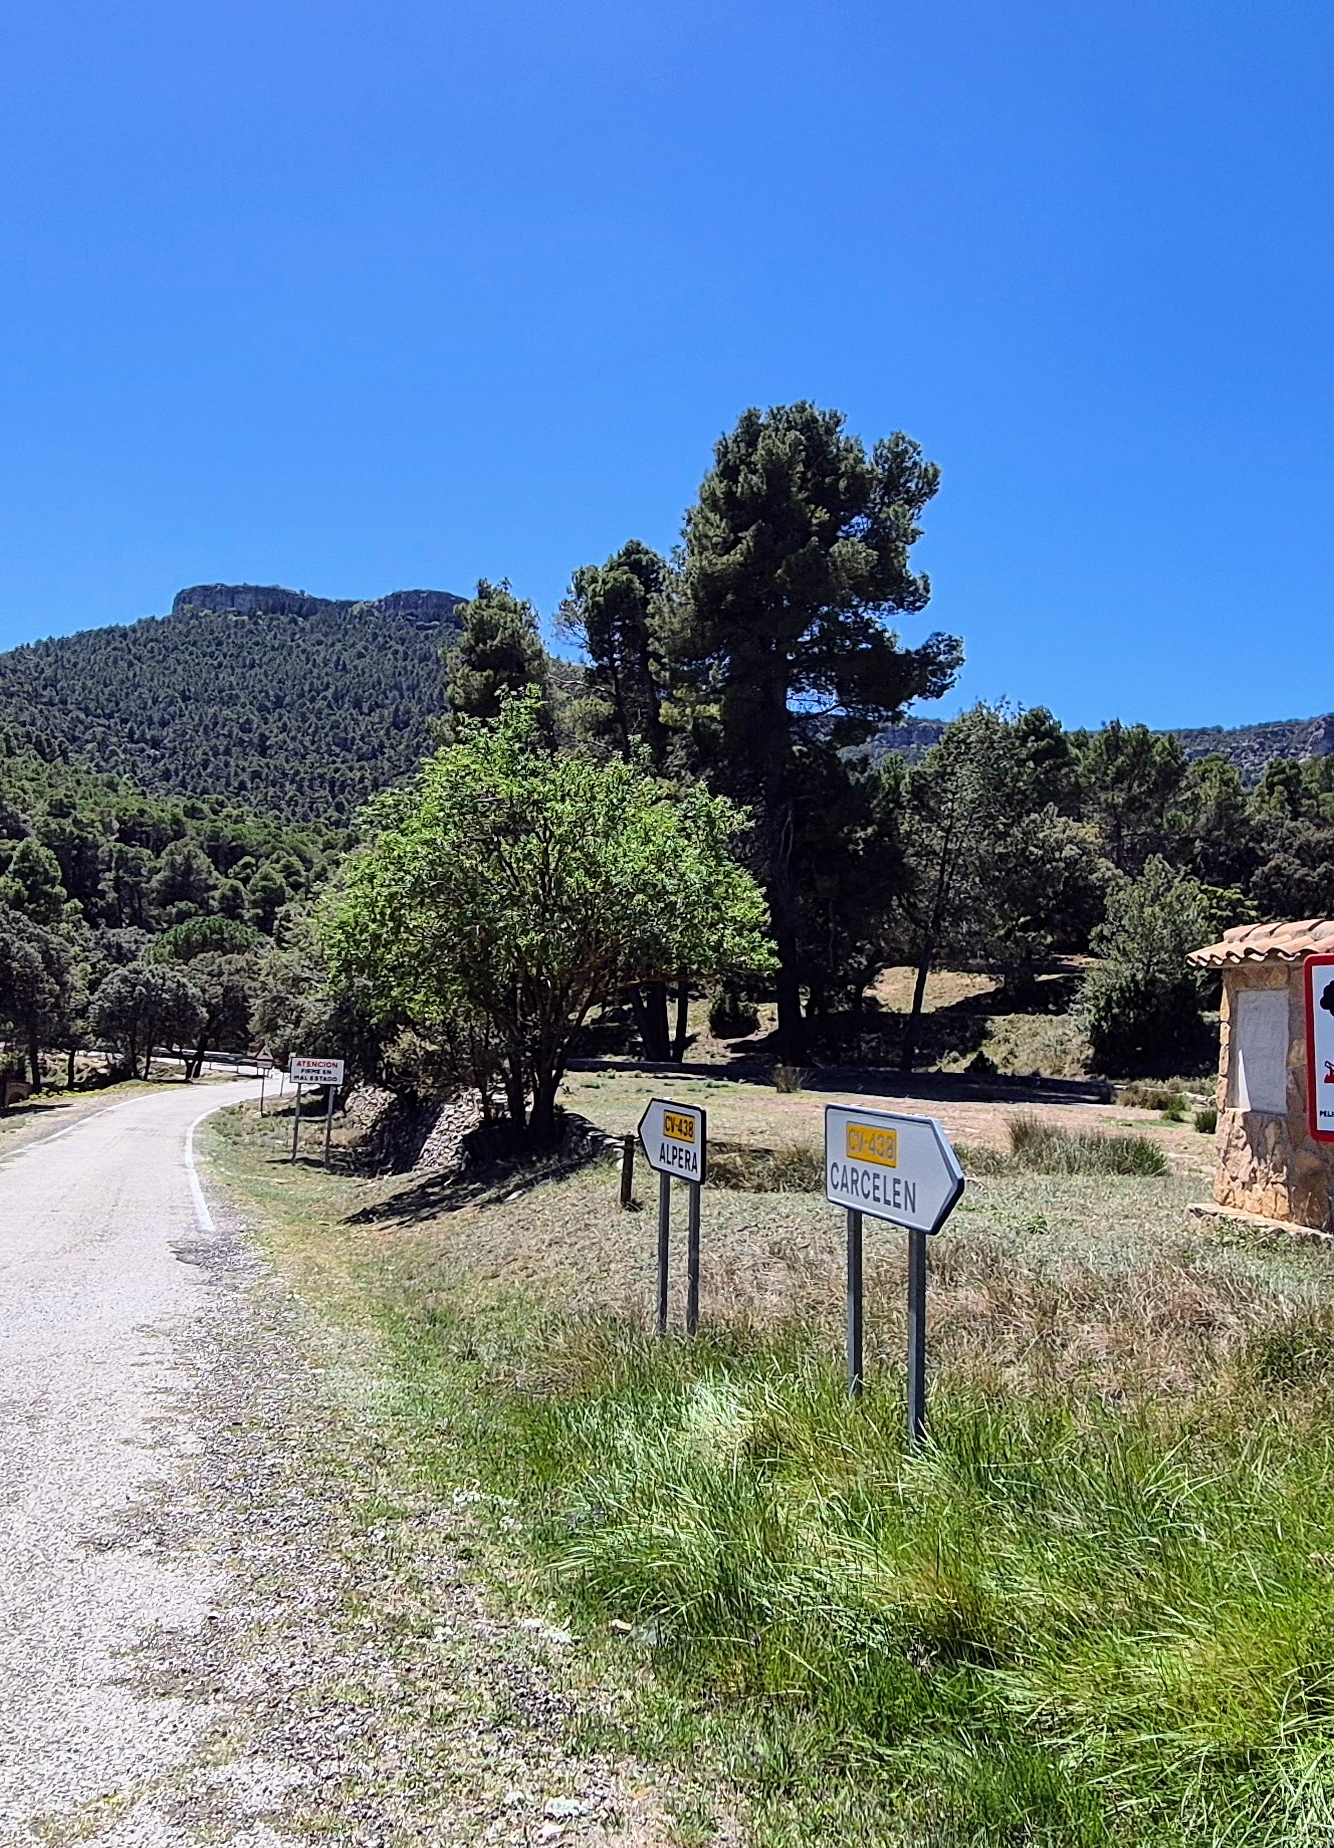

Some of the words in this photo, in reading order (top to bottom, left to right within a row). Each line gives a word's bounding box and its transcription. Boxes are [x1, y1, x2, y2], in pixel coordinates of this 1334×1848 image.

[664, 1114, 694, 1139] CV-438
[659, 1142, 698, 1175] ALPERA
[848, 1127, 896, 1161] CV-438
[829, 1161, 917, 1214] CARCELEN
